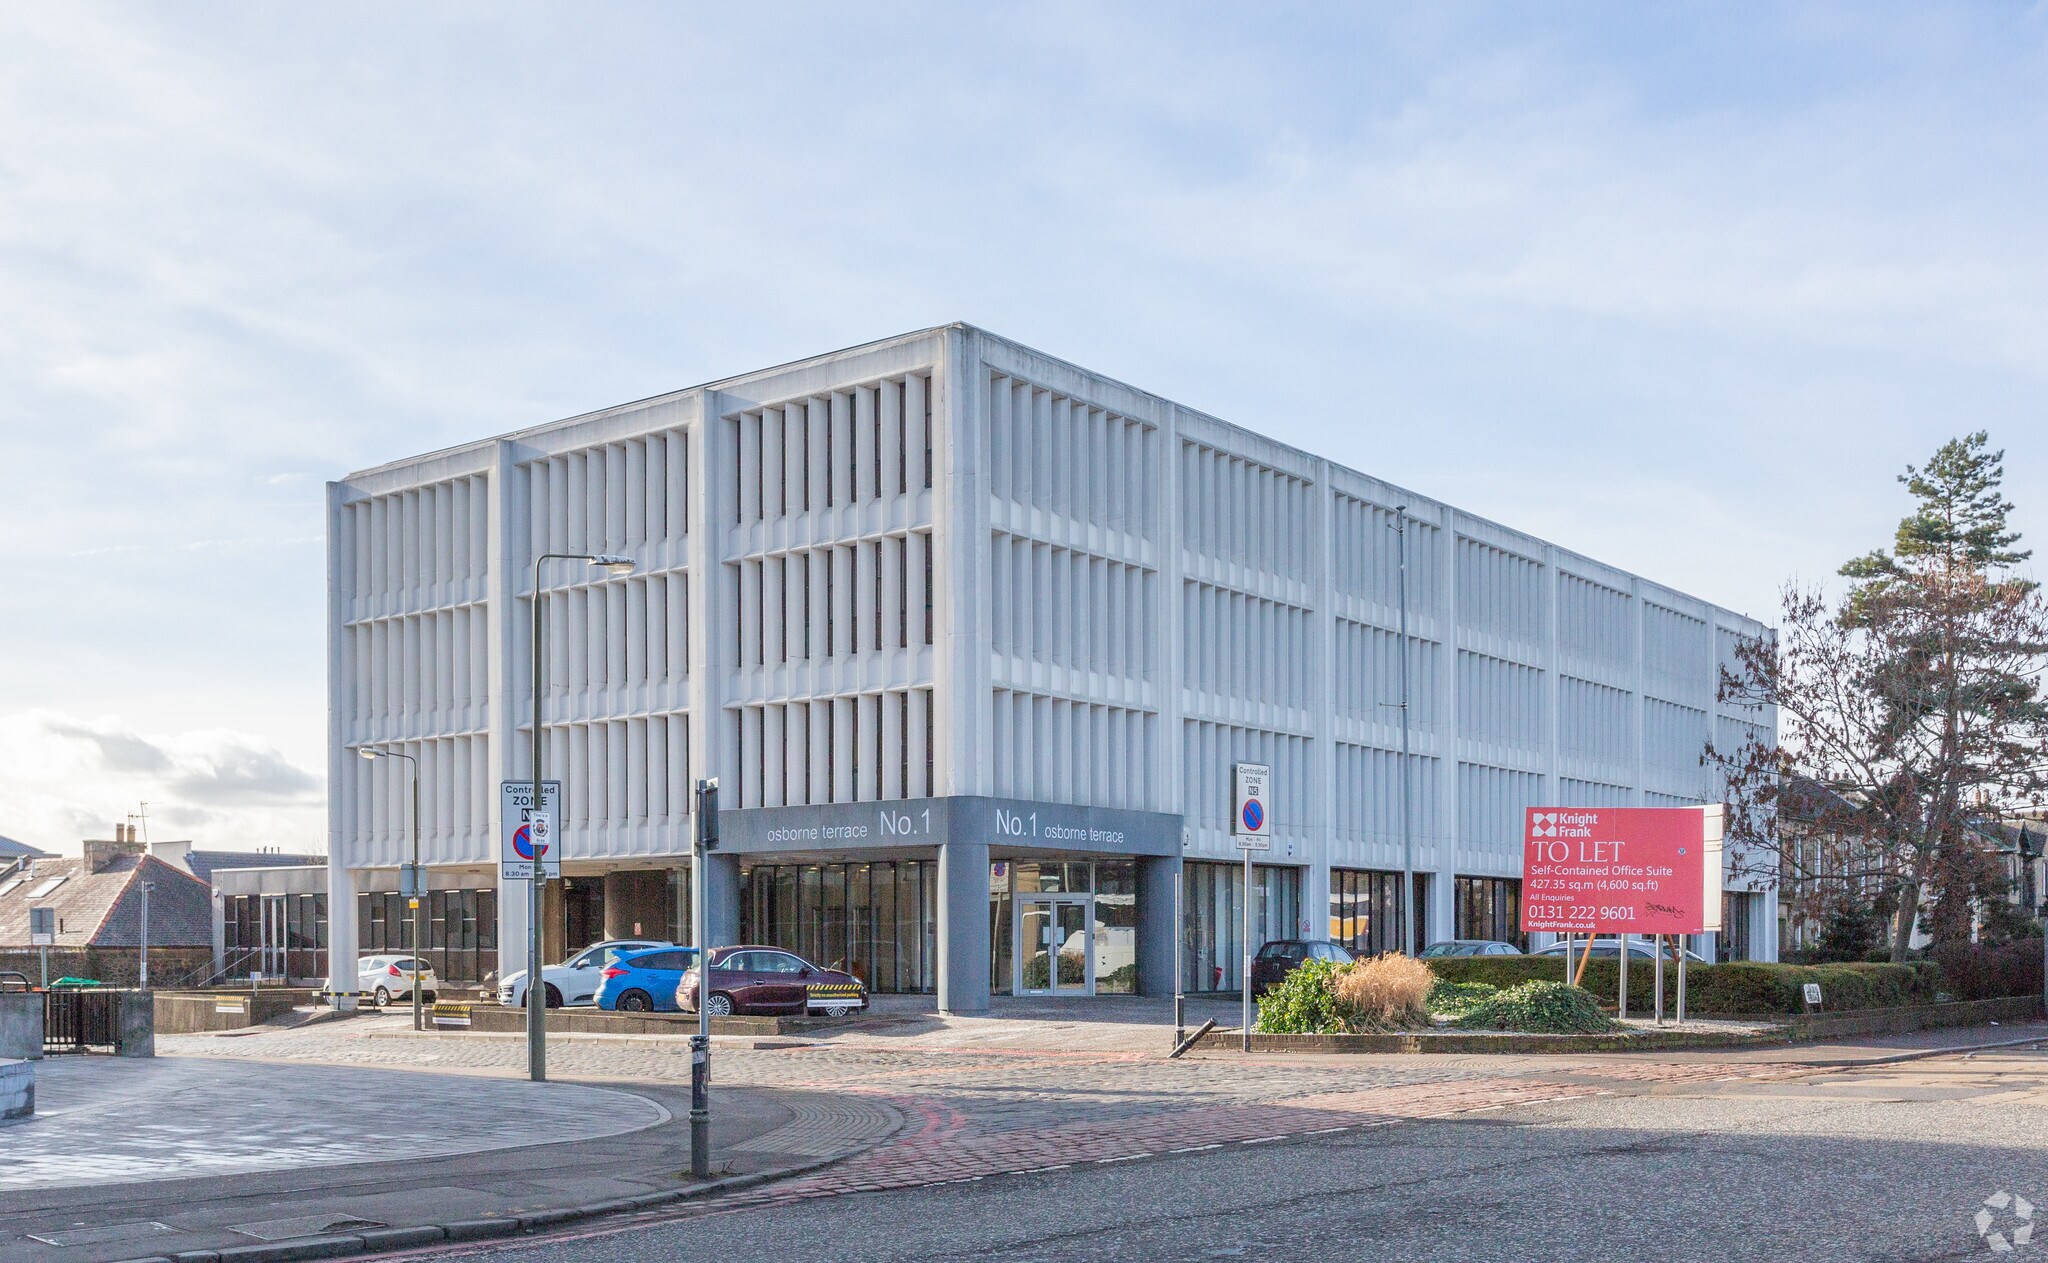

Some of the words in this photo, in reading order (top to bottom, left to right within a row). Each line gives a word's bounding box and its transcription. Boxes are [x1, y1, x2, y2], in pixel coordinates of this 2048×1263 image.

[1239, 766, 1268, 776] Controlled
[1245, 776, 1262, 785] ZONE
[505, 785, 555, 794] Contrled
[1249, 786, 1258, 796] N5
[880, 808, 930, 836] No.1
[995, 808, 1037, 837] No.1
[1559, 812, 1598, 827] Knight
[767, 826, 818, 842] osborne
[822, 825, 868, 839] terrace
[1044, 823, 1087, 843] osborne
[1089, 827, 1124, 844] terrace
[1559, 825, 1591, 838] Frank
[1531, 840, 1570, 863] TO
[1579, 840, 1626, 863] LET
[1531, 865, 1609, 876] Self-Contained
[1611, 866, 1643, 876] Office
[1646, 866, 1673, 876] Suite
[1530, 879, 1566, 890] 427.35
[1568, 882, 1594, 891] sq.m
[1597, 880, 1629, 891] (4,600
[1631, 880, 1659, 892] sq.ft)
[1541, 894, 1575, 902] Enquiries
[1528, 905, 1564, 919] 0131
[1568, 906, 1596, 920] 222
[1600, 906, 1636, 920] 9601
[1528, 920, 1596, 929] KnightFrank.co.uk
